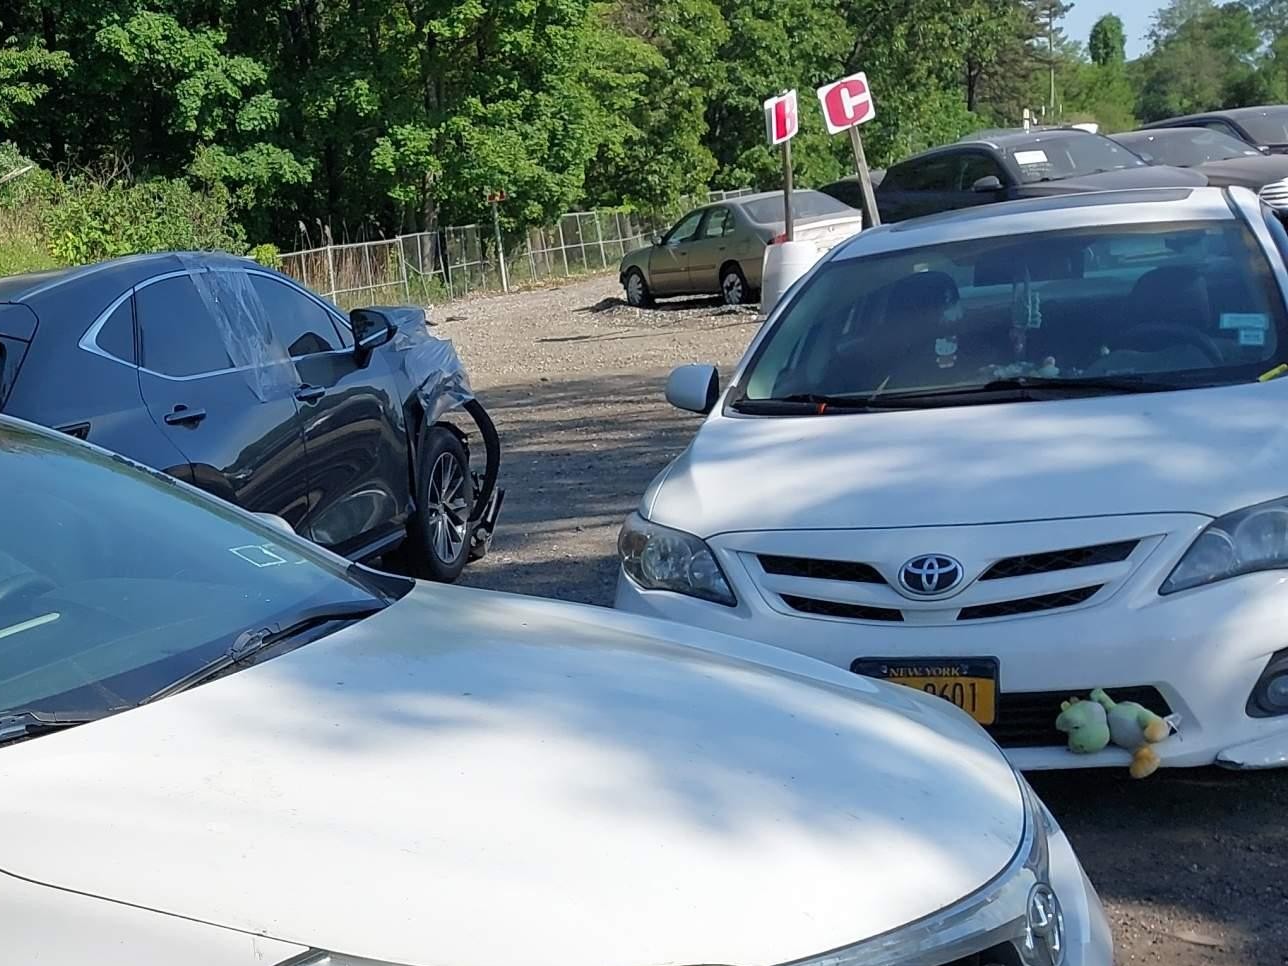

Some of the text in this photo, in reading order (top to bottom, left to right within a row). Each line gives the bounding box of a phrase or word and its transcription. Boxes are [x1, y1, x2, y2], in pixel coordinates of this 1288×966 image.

[825, 79, 870, 127] C
[889, 666, 961, 677] NEW YORK
